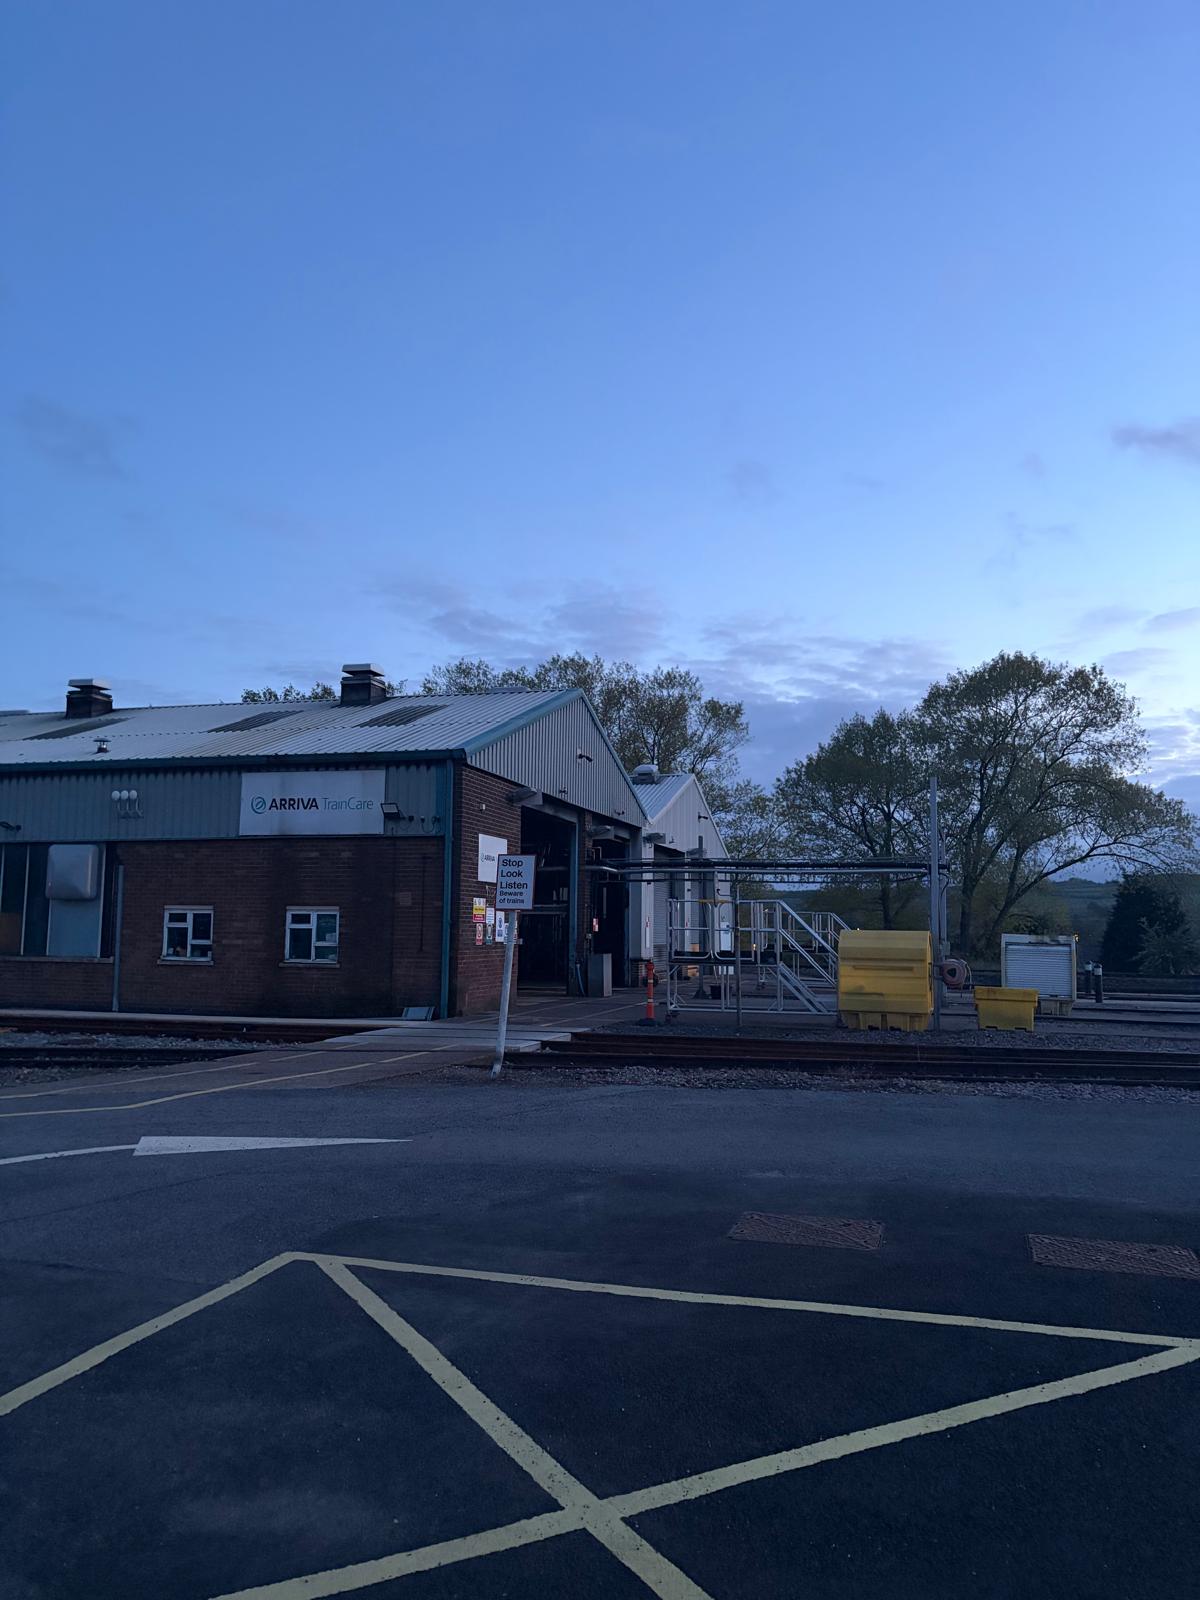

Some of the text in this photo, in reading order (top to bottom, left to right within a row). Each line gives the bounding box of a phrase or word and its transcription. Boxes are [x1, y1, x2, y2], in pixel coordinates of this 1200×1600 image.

[269, 797, 374, 810] ARRIVA TrainCare
[502, 859, 523, 868] Stop
[500, 881, 528, 889] Listen
